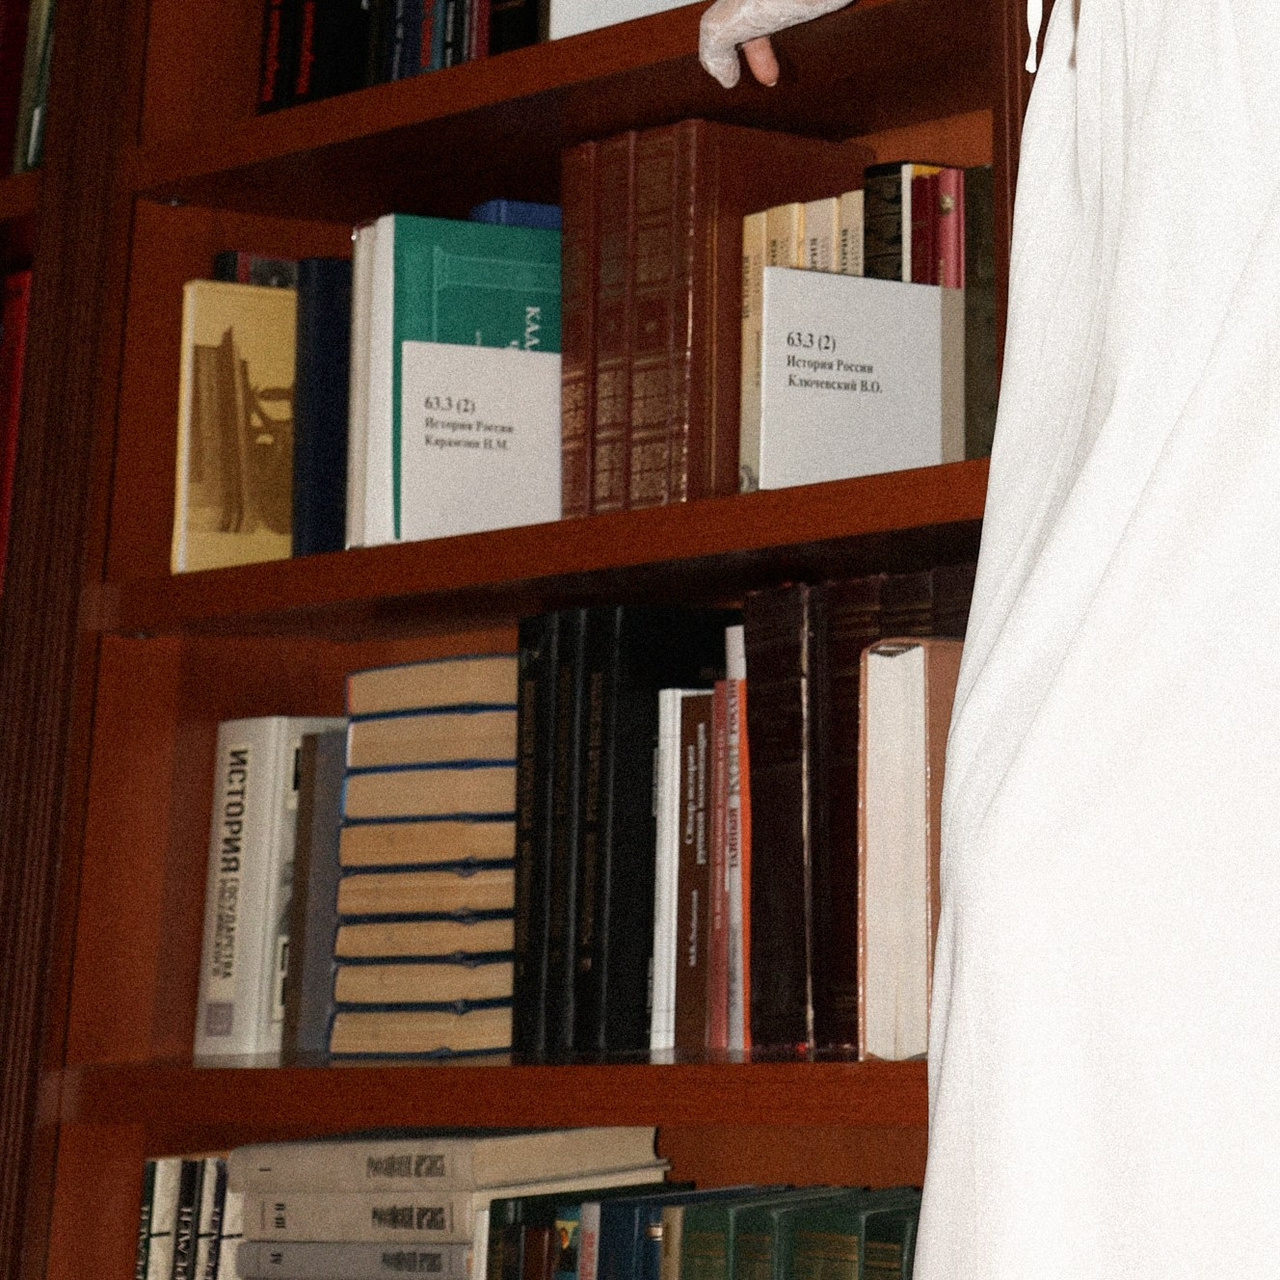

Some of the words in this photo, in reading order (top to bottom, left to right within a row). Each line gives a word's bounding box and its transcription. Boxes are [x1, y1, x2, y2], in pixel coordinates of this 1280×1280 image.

[787, 332, 814, 347] 63.3
[818, 335, 836, 354] (2)
[786, 355, 833, 371] История
[837, 360, 873, 373] России
[788, 375, 857, 390] Ключевский
[861, 381, 883, 393] В.О.
[424, 396, 453, 410] 63.3
[425, 417, 472, 432] История
[476, 421, 514, 433] России
[221, 750, 247, 872] ИСТОРИЯ
